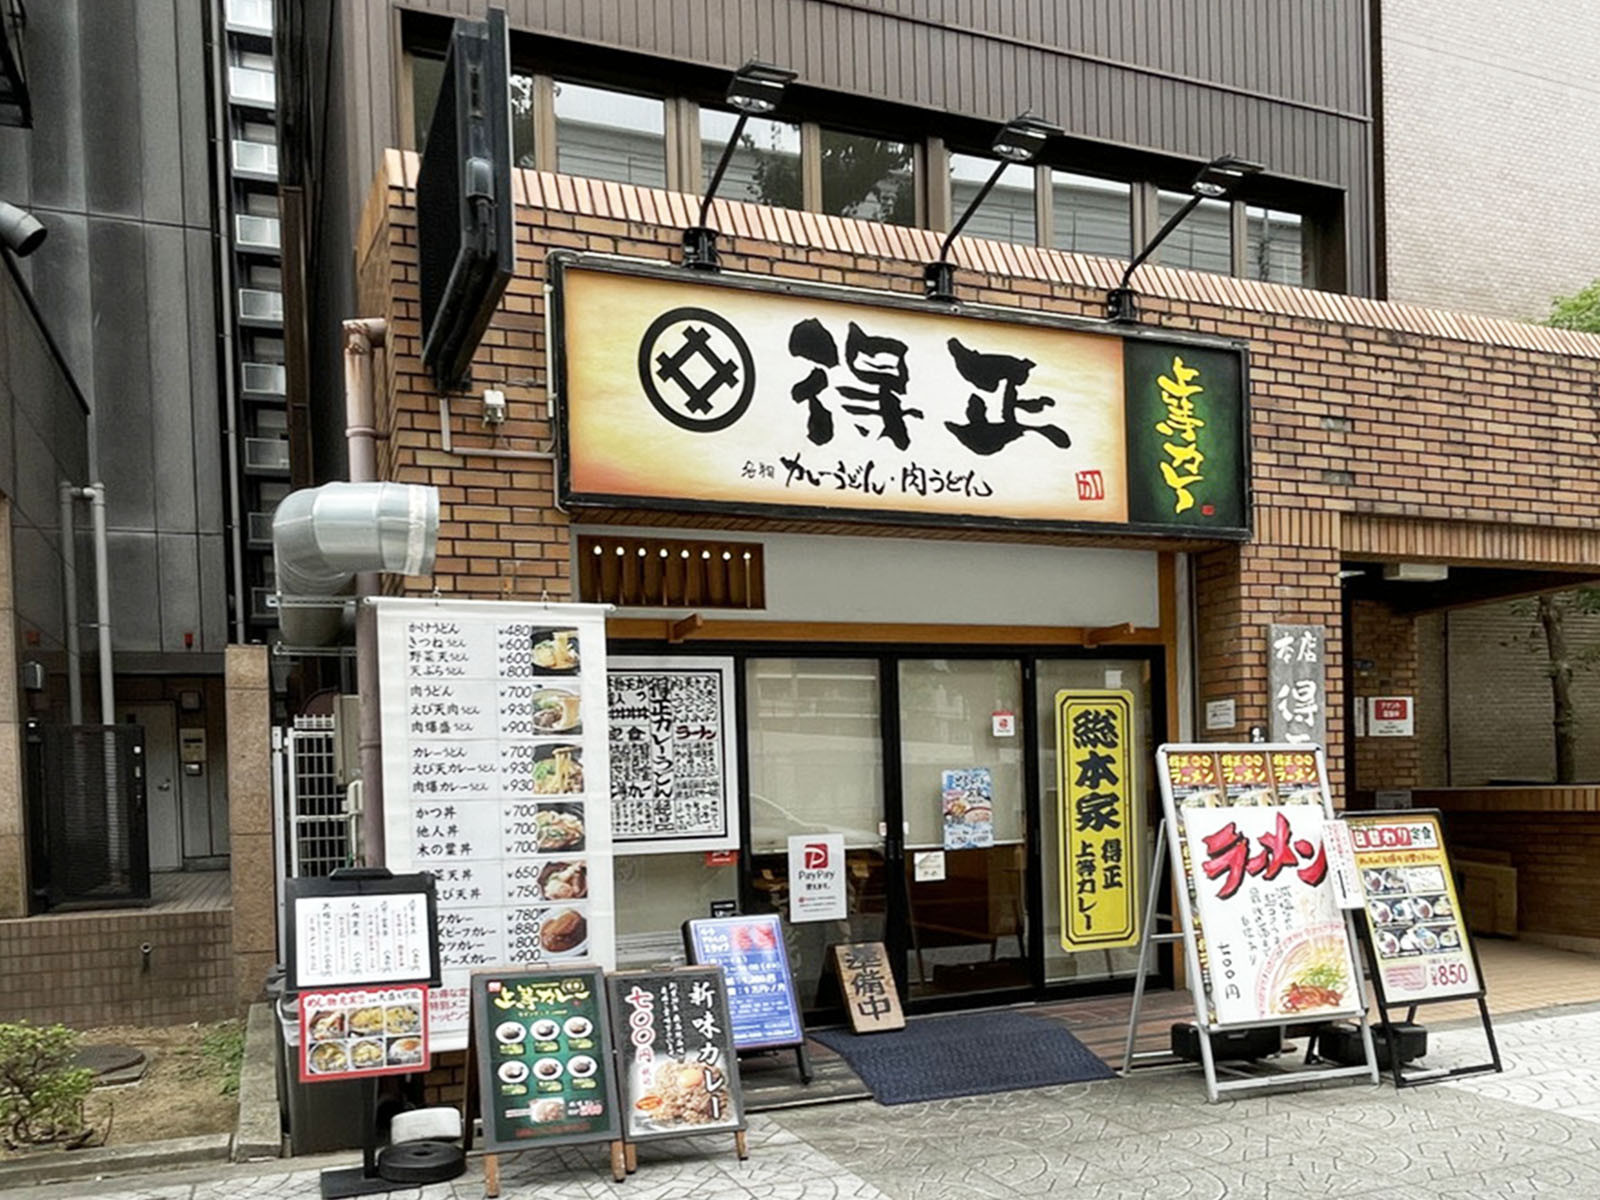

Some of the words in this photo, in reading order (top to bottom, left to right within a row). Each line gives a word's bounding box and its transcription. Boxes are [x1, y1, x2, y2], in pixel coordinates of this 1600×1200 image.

[789, 317, 1071, 458] 得正
[409, 622, 460, 634] かけうどん
[498, 624, 531, 636] ¥480
[409, 636, 467, 649] きつねうどん
[499, 638, 532, 651] ¥600
[1273, 630, 1317, 664] 本店
[409, 650, 469, 663] 野菜天うどん
[499, 652, 532, 664] ¥600
[409, 665, 466, 676] 天ぷらうどん
[500, 666, 532, 678] ¥800
[410, 685, 454, 697] 肉うどん
[500, 686, 532, 698] ¥700
[411, 703, 480, 716] えび天肉うどん
[500, 703, 532, 716] ¥930
[1277, 680, 1318, 744] 得
[501, 721, 533, 733] ¥900
[413, 747, 467, 758] カレーうどん
[501, 746, 534, 758] ¥700
[412, 763, 497, 775] えび天カレーうどん
[502, 761, 535, 774] ¥930
[1072, 709, 1121, 832] 総本家
[503, 779, 535, 791] ¥930
[416, 805, 456, 819] かつ丼
[504, 804, 537, 817] ¥700
[416, 824, 459, 838] 他人丼
[505, 822, 537, 835] ¥700
[505, 840, 538, 853] ¥700
[1202, 811, 1329, 900] ラーメン
[1100, 839, 1123, 890] 得正
[507, 866, 539, 879] ¥650
[798, 870, 835, 881] PayPay
[508, 885, 539, 898] ¥750
[507, 908, 539, 920] ¥780
[508, 922, 540, 935] ¥880
[508, 935, 540, 948] ¥800
[510, 949, 541, 962] ¥900
[845, 946, 891, 1021] 準備中
[689, 982, 724, 1120] 新味カレー
